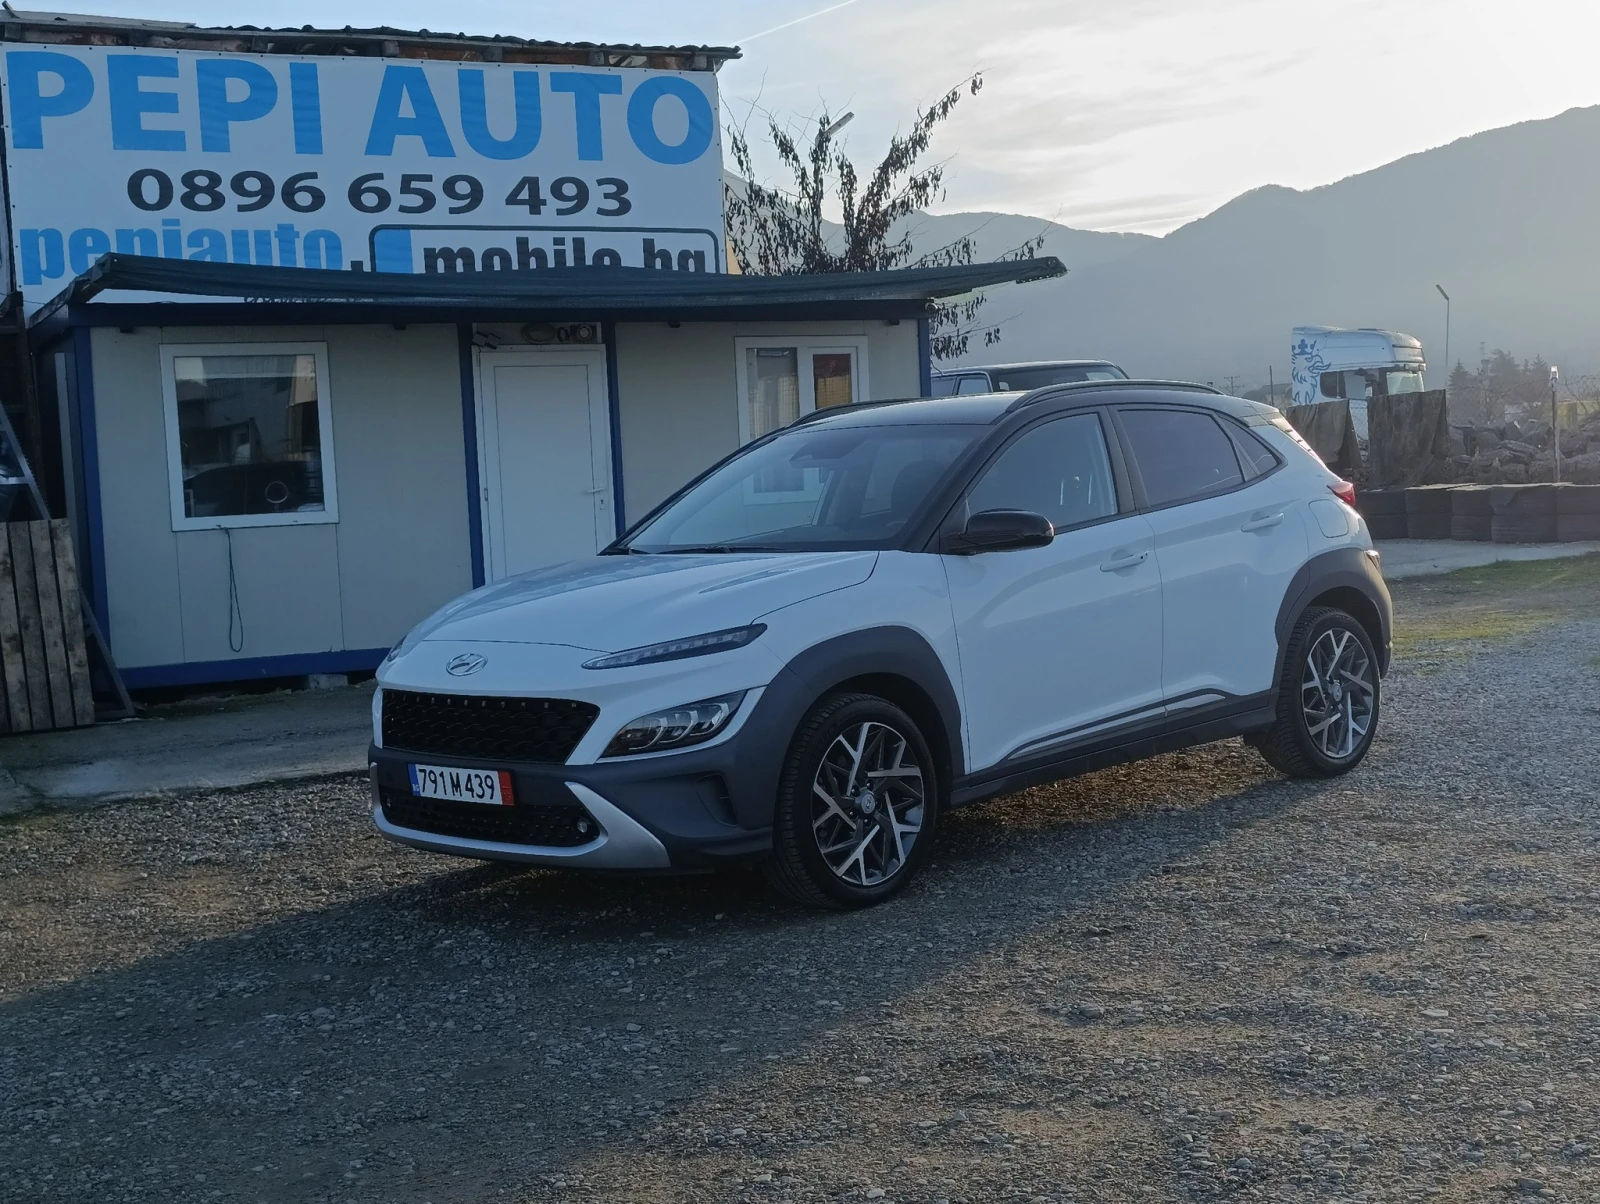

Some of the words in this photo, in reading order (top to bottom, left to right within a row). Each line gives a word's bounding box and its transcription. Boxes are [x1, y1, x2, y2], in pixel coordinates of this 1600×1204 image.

[5, 50, 324, 154] PEPI
[364, 64, 714, 164] AUTO
[127, 168, 326, 213] 0896
[347, 172, 484, 214] 659
[505, 176, 632, 217] 493
